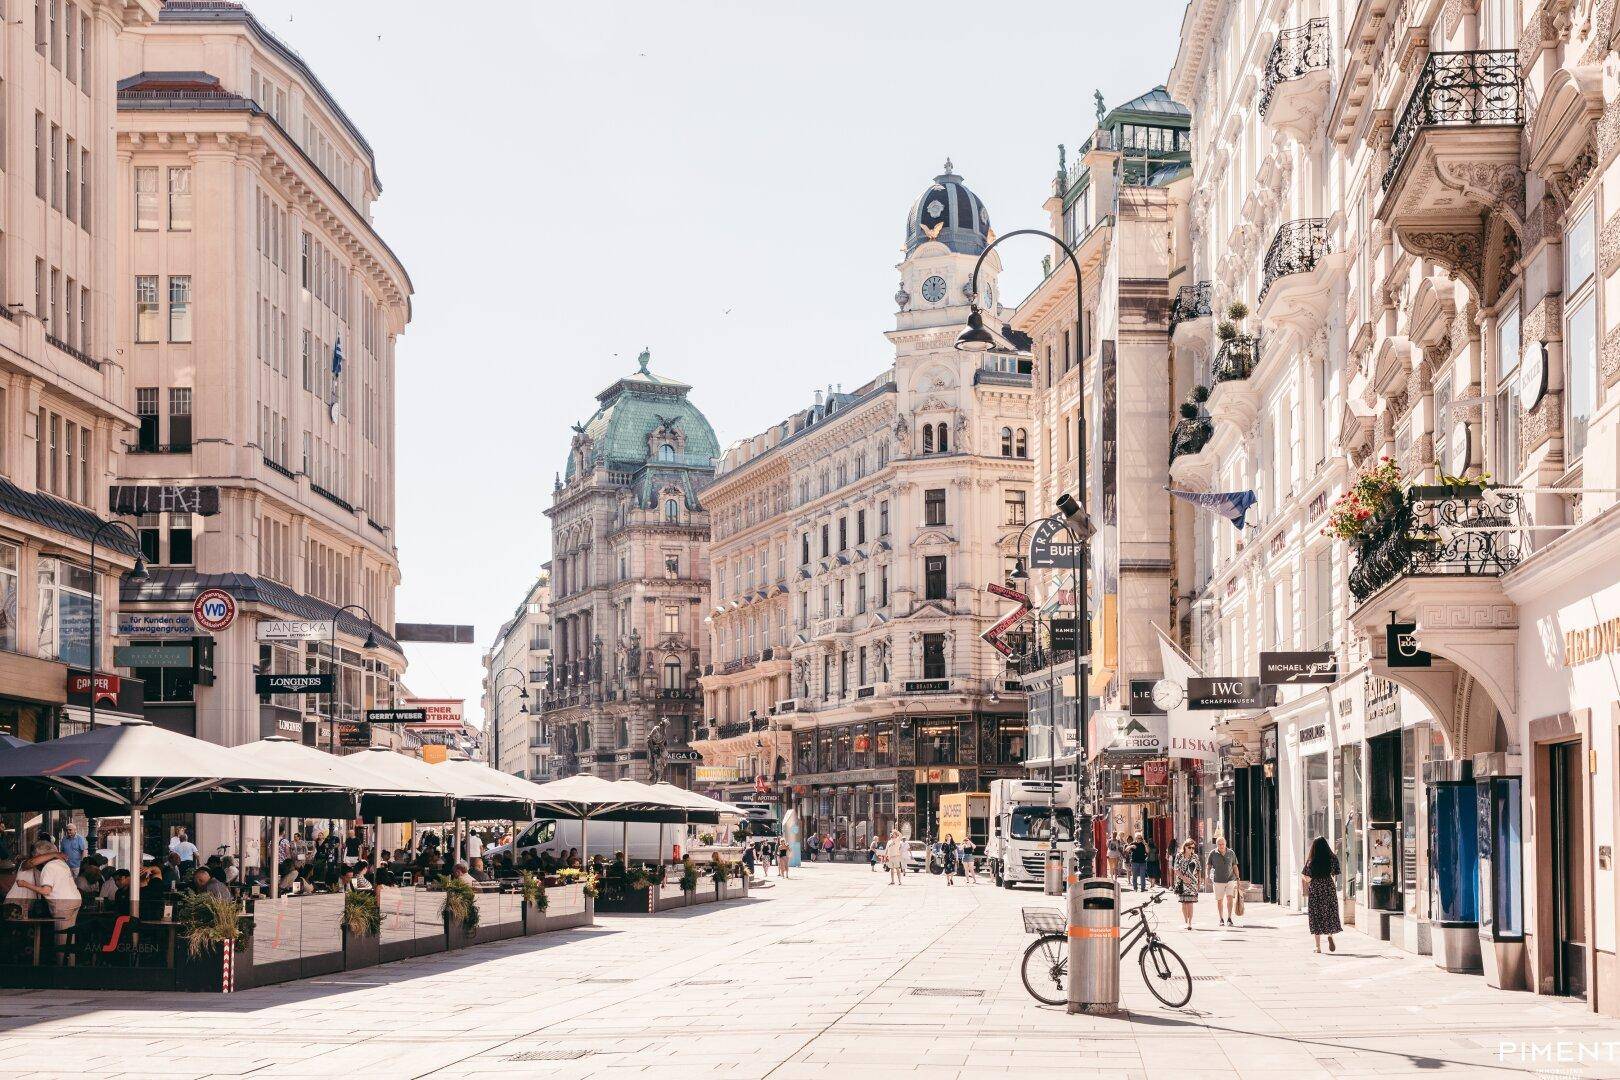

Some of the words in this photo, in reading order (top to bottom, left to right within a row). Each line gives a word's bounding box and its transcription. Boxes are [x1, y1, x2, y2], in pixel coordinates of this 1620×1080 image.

[1050, 545, 1081, 556] BUFF
[205, 603, 226, 617] VVD
[130, 616, 142, 624] für
[144, 616, 175, 624] Kunden
[176, 616, 190, 624] der
[265, 622, 328, 633] JANECKA
[1268, 664, 1304, 672] MICHAEL
[269, 678, 322, 686] LONGINES
[1212, 682, 1243, 696] IWC
[396, 712, 423, 720] WEBER
[1125, 738, 1160, 747] FRIGO
[1172, 737, 1216, 752] LISKA
[117, 943, 160, 953] GRABEN
